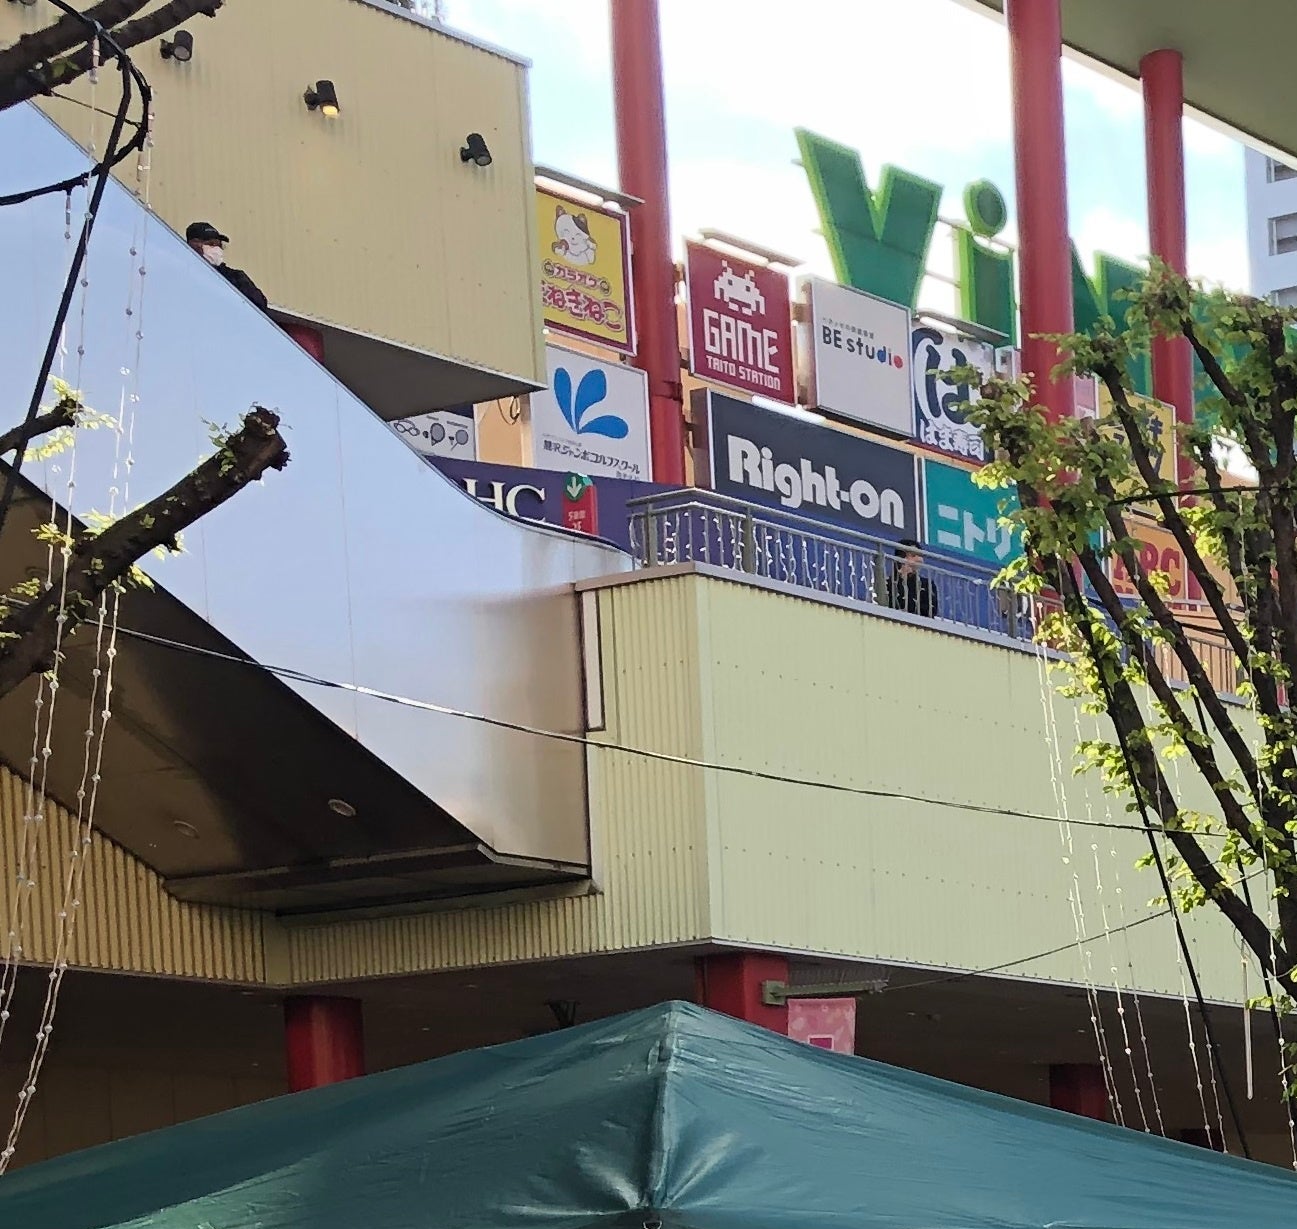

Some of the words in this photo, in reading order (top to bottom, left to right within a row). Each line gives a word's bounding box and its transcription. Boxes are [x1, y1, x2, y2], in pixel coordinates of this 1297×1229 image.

[703, 308, 780, 373] GAME
[822, 325, 843, 349] BE
[846, 335, 905, 370] studio
[705, 355, 738, 377] TAITO
[738, 367, 781, 391] STATION
[727, 434, 905, 530] Right-on
